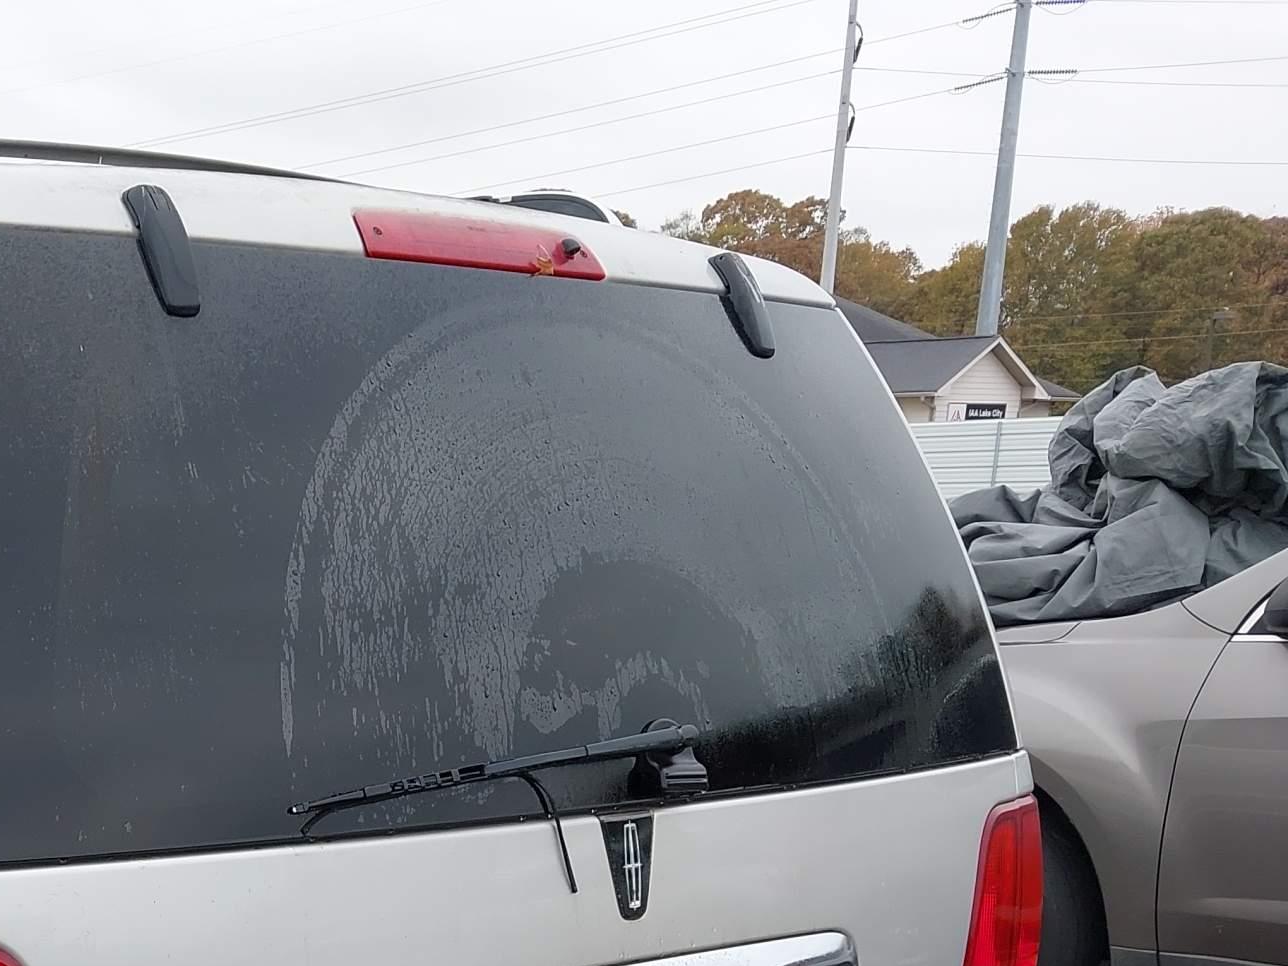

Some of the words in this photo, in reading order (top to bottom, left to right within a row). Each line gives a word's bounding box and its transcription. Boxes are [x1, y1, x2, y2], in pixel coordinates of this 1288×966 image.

[968, 408, 979, 417] IAA
[979, 408, 992, 417] Lake
[992, 408, 1004, 419] City
